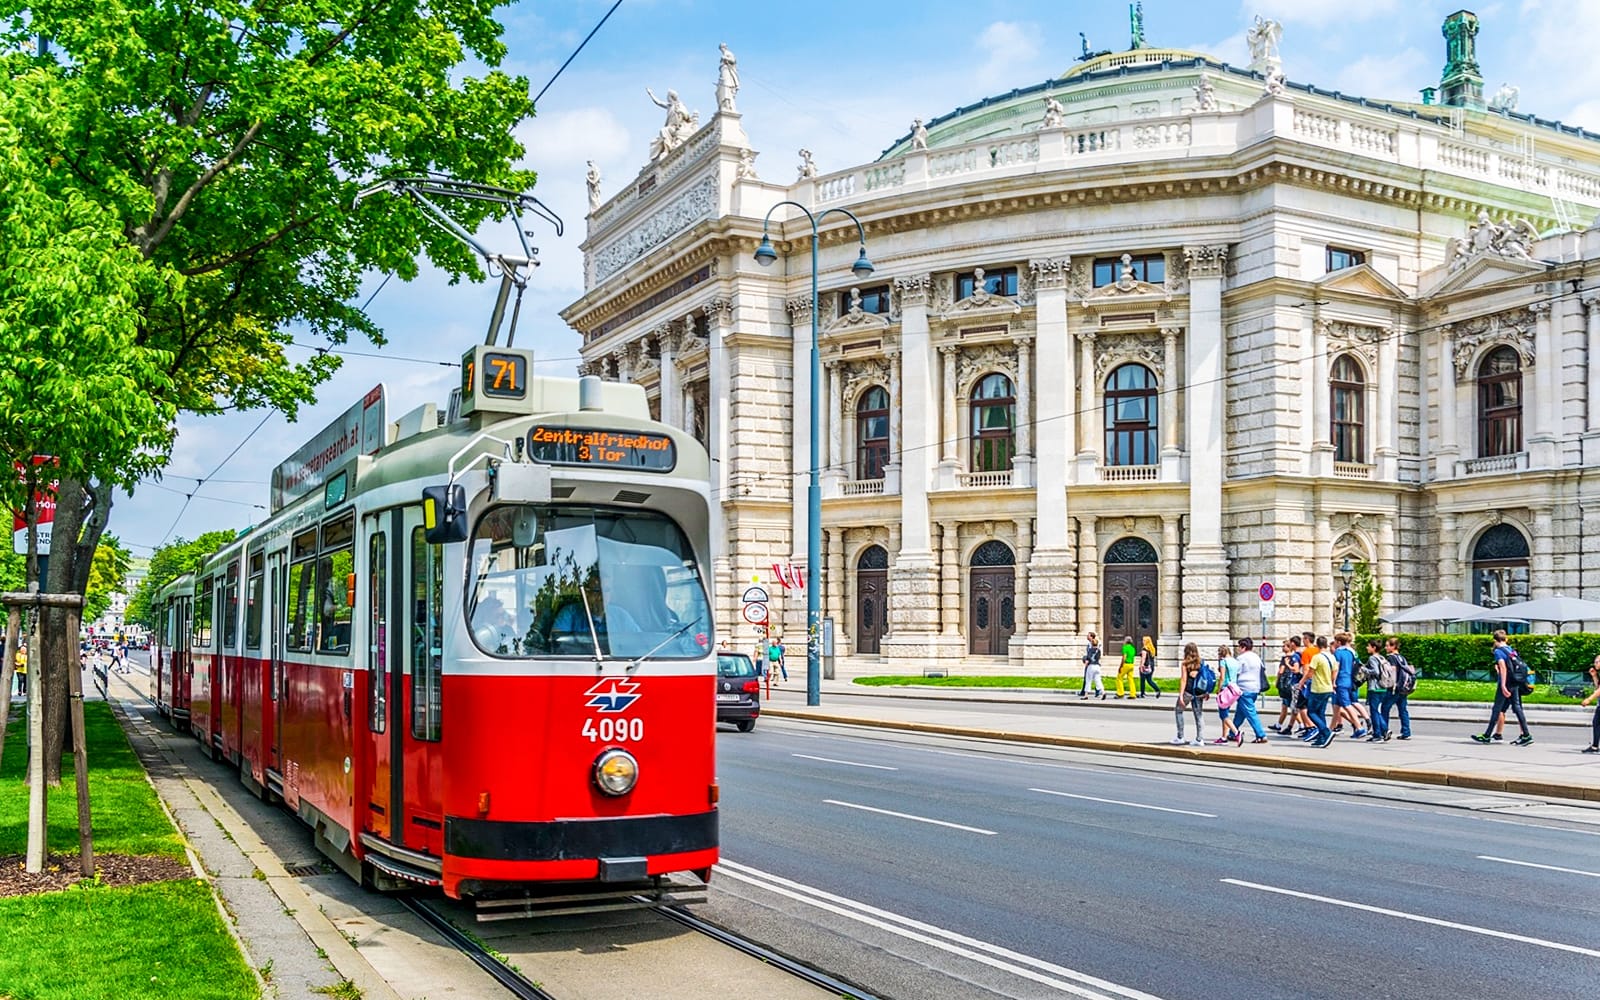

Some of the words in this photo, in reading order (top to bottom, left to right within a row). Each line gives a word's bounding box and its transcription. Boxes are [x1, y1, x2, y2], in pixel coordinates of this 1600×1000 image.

[491, 359, 516, 390] 71
[532, 428, 670, 450] Zentralfriedhof
[579, 447, 593, 461] 3.
[598, 448, 626, 461] Tor
[581, 718, 644, 742] 4090
